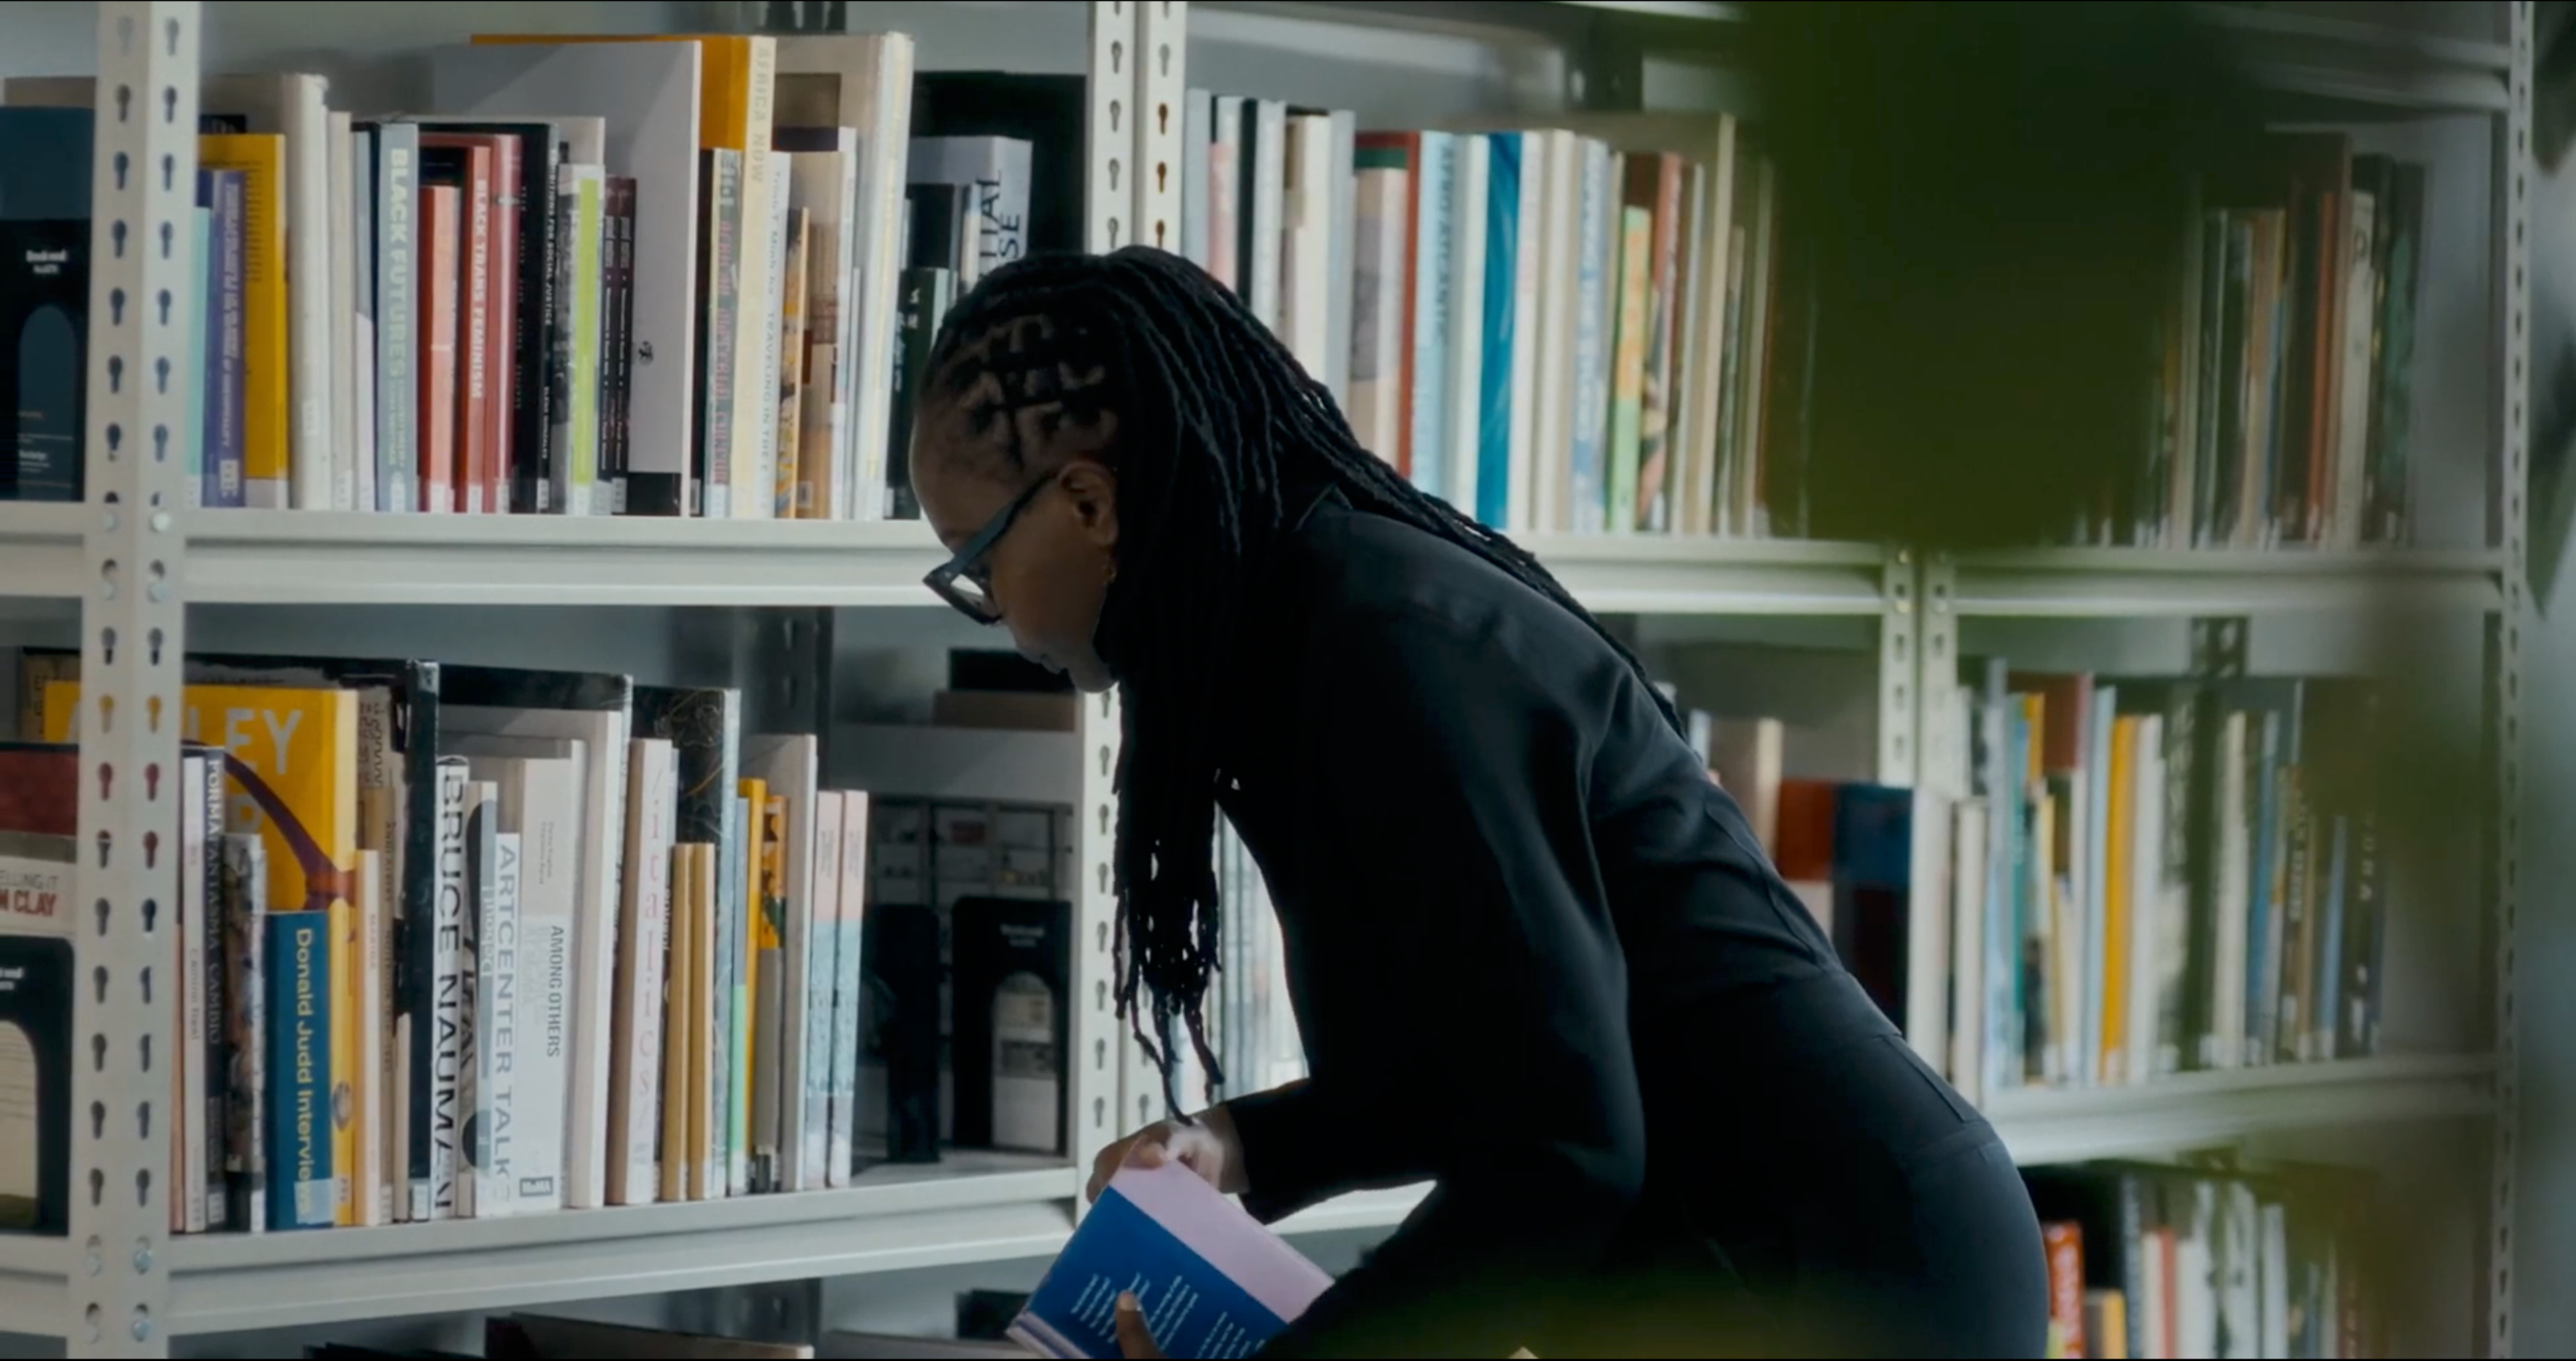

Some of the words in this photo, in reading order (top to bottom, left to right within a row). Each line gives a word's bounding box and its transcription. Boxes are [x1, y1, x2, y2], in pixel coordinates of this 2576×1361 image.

[756, 48, 769, 122] AFRICA
[751, 133, 765, 182] NOW
[390, 149, 408, 243] BLACK
[475, 178, 488, 239] BLACK
[473, 242, 486, 301] TRANS
[545, 241, 555, 280] SOCIAL
[389, 250, 407, 377] FUTURES
[471, 307, 484, 398] FEMINISM
[438, 774, 464, 953] BRUCE
[13, 889, 57, 918] CLAY
[296, 928, 315, 1017] Donald
[496, 844, 517, 1075] ARTCENTER
[549, 926, 565, 989] AMONG
[296, 1020, 315, 1084] Judd
[547, 992, 563, 1058] OTHERS
